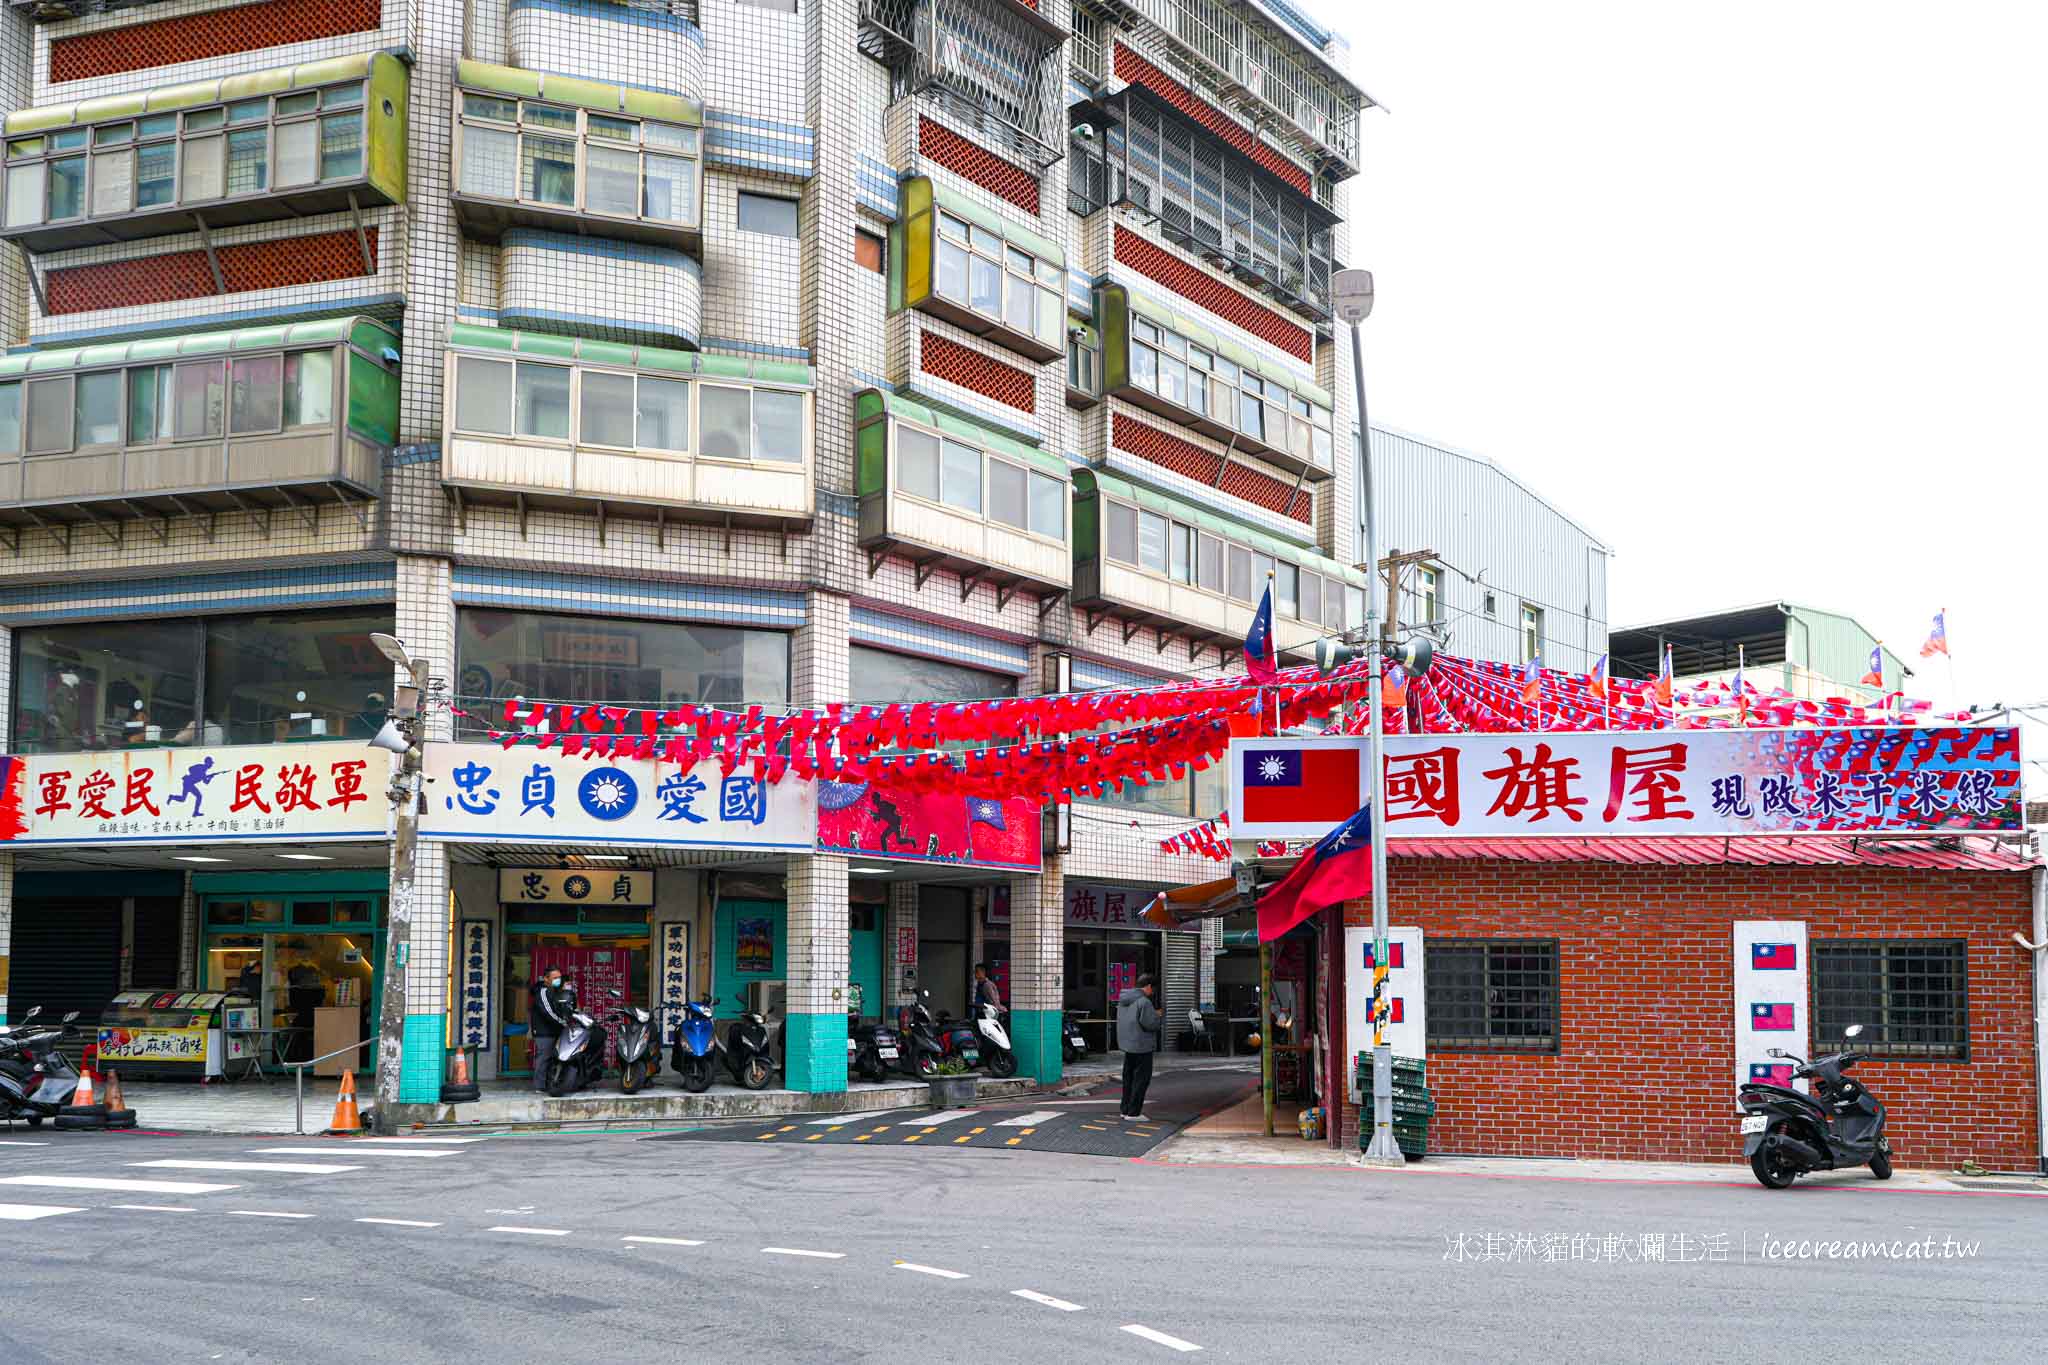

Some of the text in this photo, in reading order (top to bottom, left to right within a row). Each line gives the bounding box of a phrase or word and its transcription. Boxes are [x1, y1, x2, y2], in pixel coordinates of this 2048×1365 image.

[35, 759, 368, 820] 軍愛民 民敬軍
[446, 760, 767, 826] 忠貞 愛國
[1384, 743, 2004, 827] 國旗屋 現做米干米線
[1069, 889, 1128, 924] 旗屋
